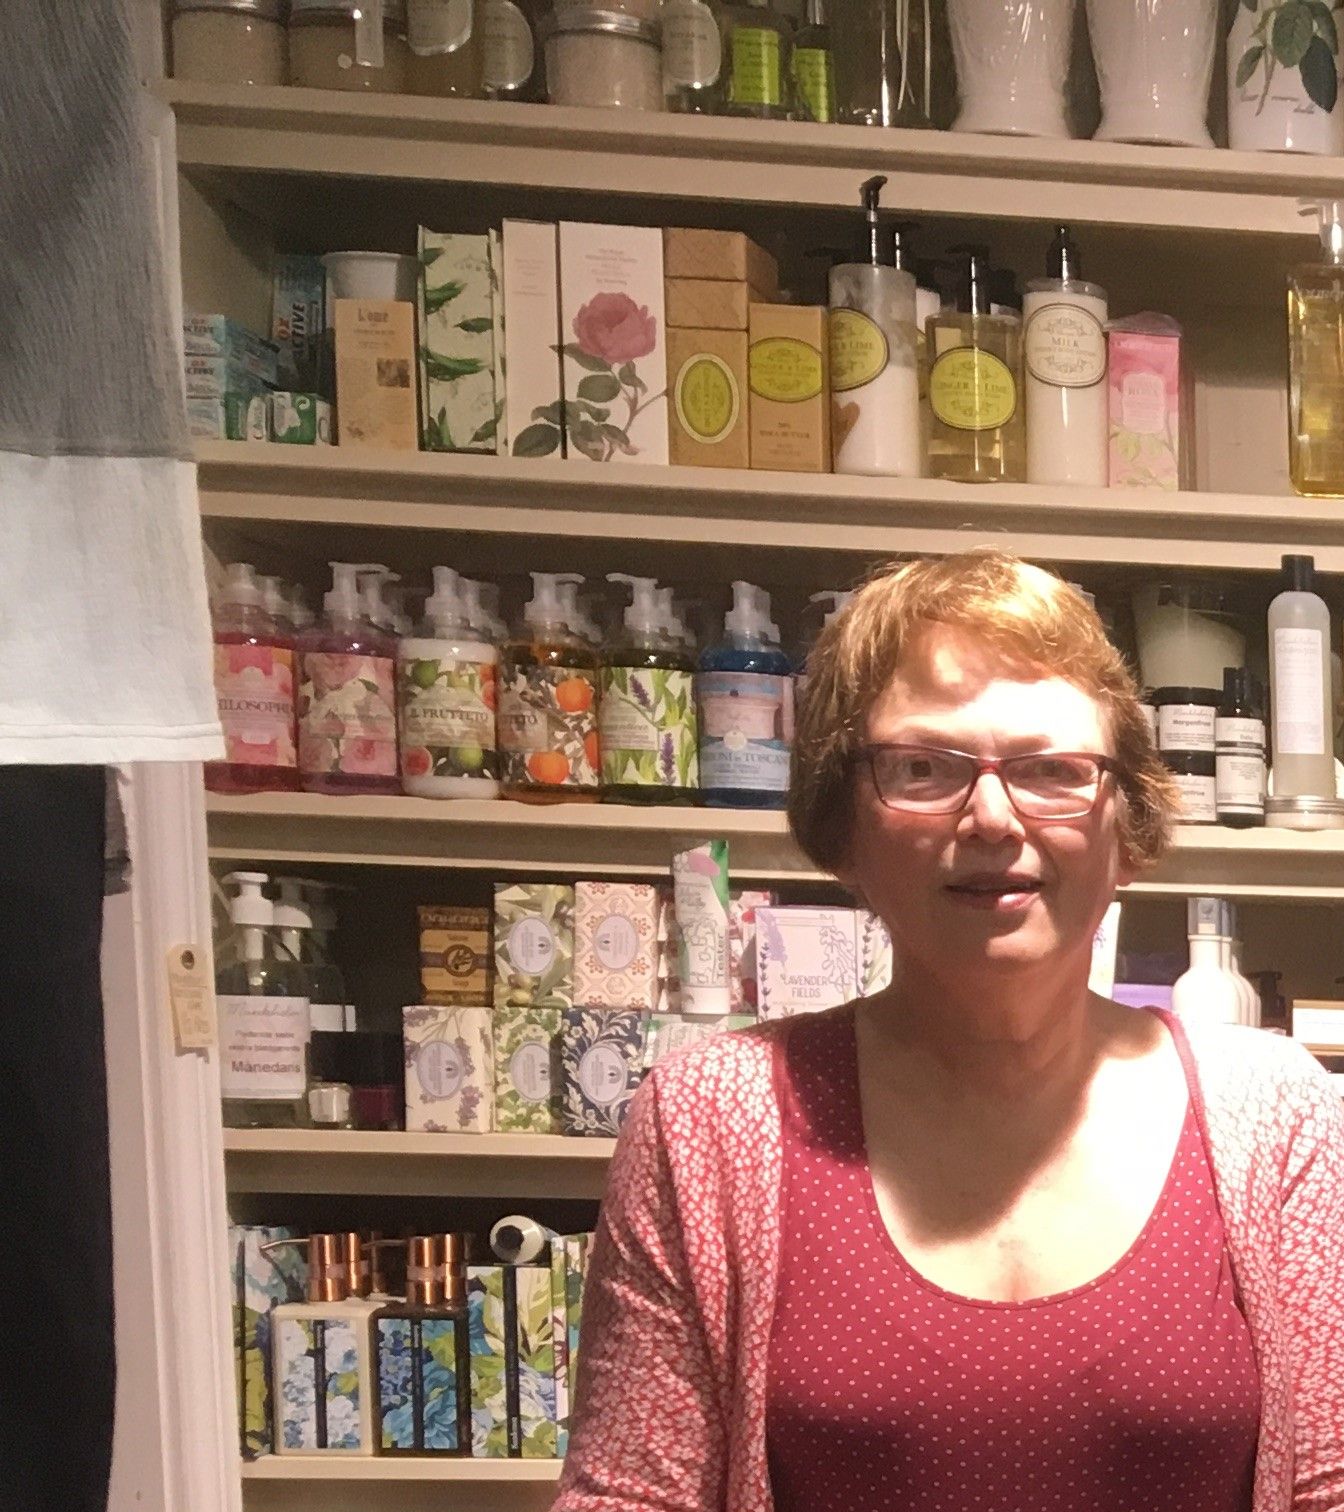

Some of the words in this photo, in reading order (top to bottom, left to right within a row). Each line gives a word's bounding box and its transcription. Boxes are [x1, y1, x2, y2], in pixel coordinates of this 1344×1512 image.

[1051, 336, 1080, 348] MILK
[716, 932, 725, 979] Tester
[783, 974, 830, 986] LAVENDER
[791, 987, 822, 999] FIELDS
